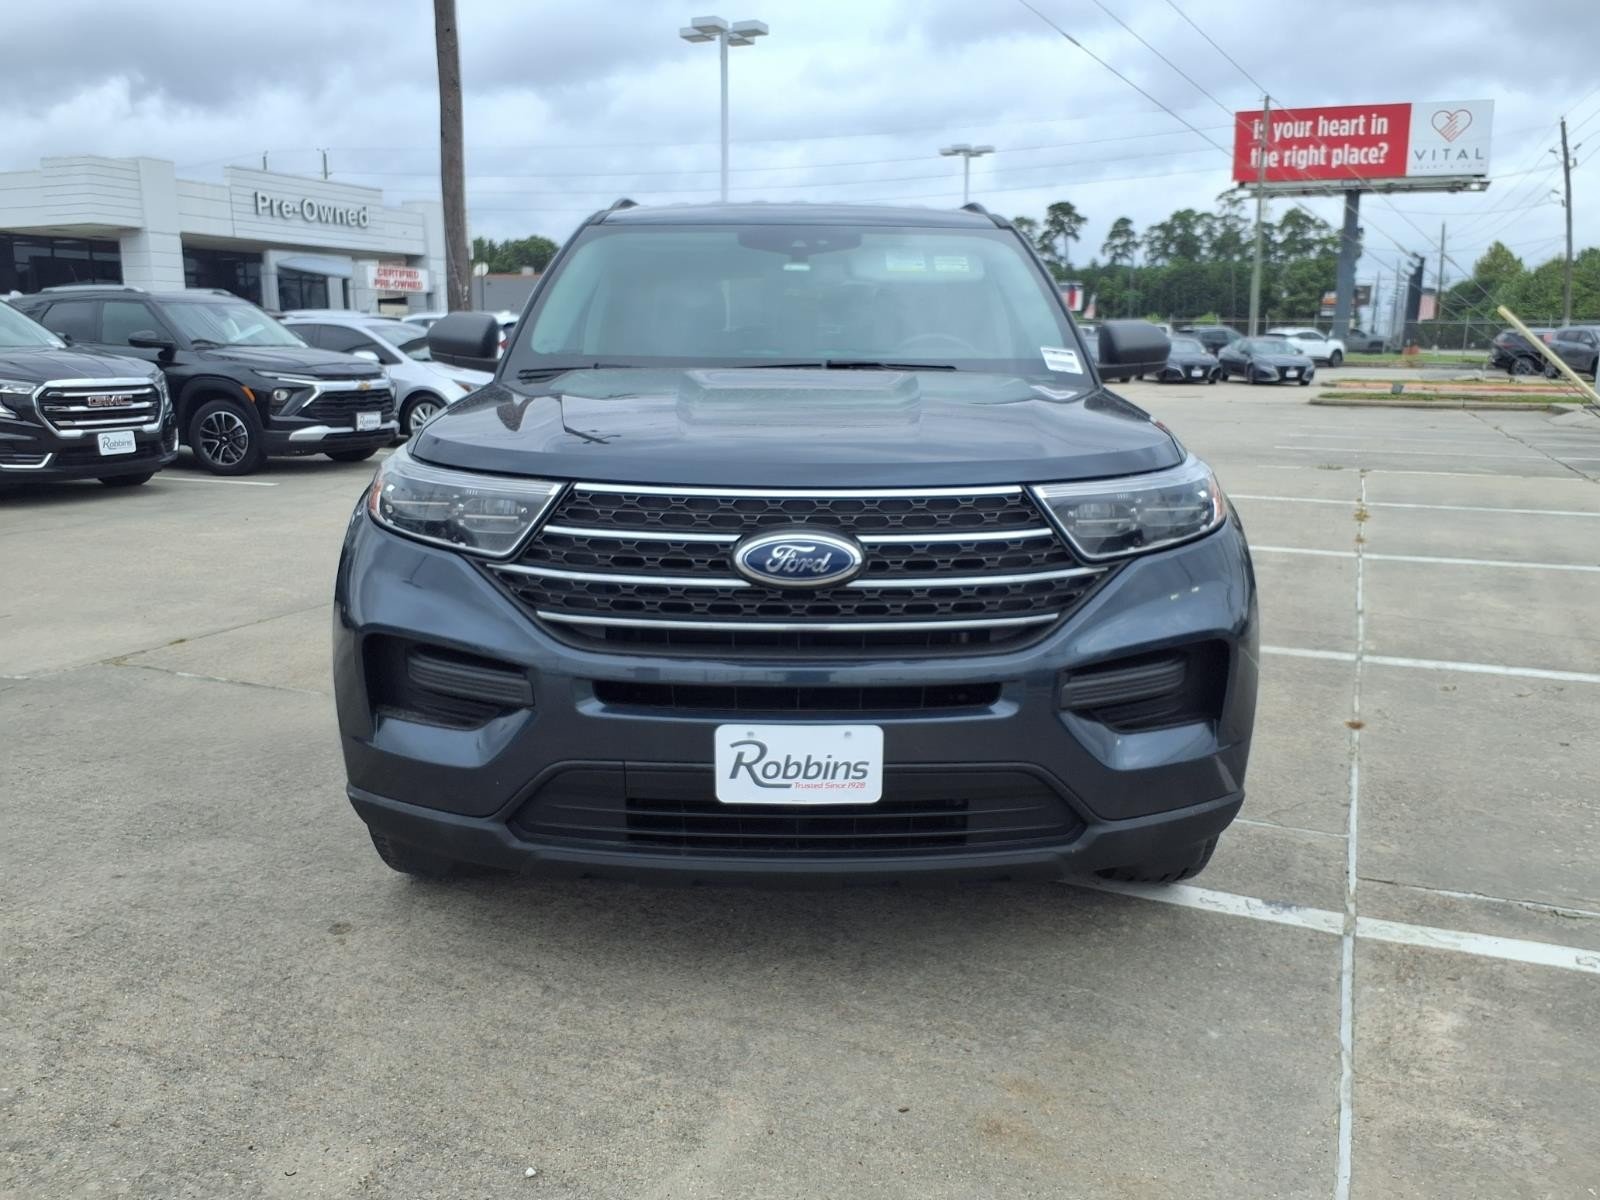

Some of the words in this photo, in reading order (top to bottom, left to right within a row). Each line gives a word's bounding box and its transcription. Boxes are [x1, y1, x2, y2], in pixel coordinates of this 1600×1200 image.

[1273, 120, 1313, 143] your
[1317, 114, 1366, 137] heart
[1370, 113, 1388, 135] in
[1250, 147, 1279, 168] the
[1283, 144, 1327, 169] right
[1331, 142, 1389, 168] place?
[1414, 147, 1484, 161] VITAL
[254, 190, 371, 228] Pre-Owned
[374, 279, 423, 289] PRE-OWNED
[377, 267, 419, 279] CERTIFIED
[765, 544, 832, 573] Ford
[729, 739, 870, 789] Robbins
[794, 781, 823, 789] Trusted
[825, 781, 846, 789] Since
[847, 781, 866, 789] 1928
